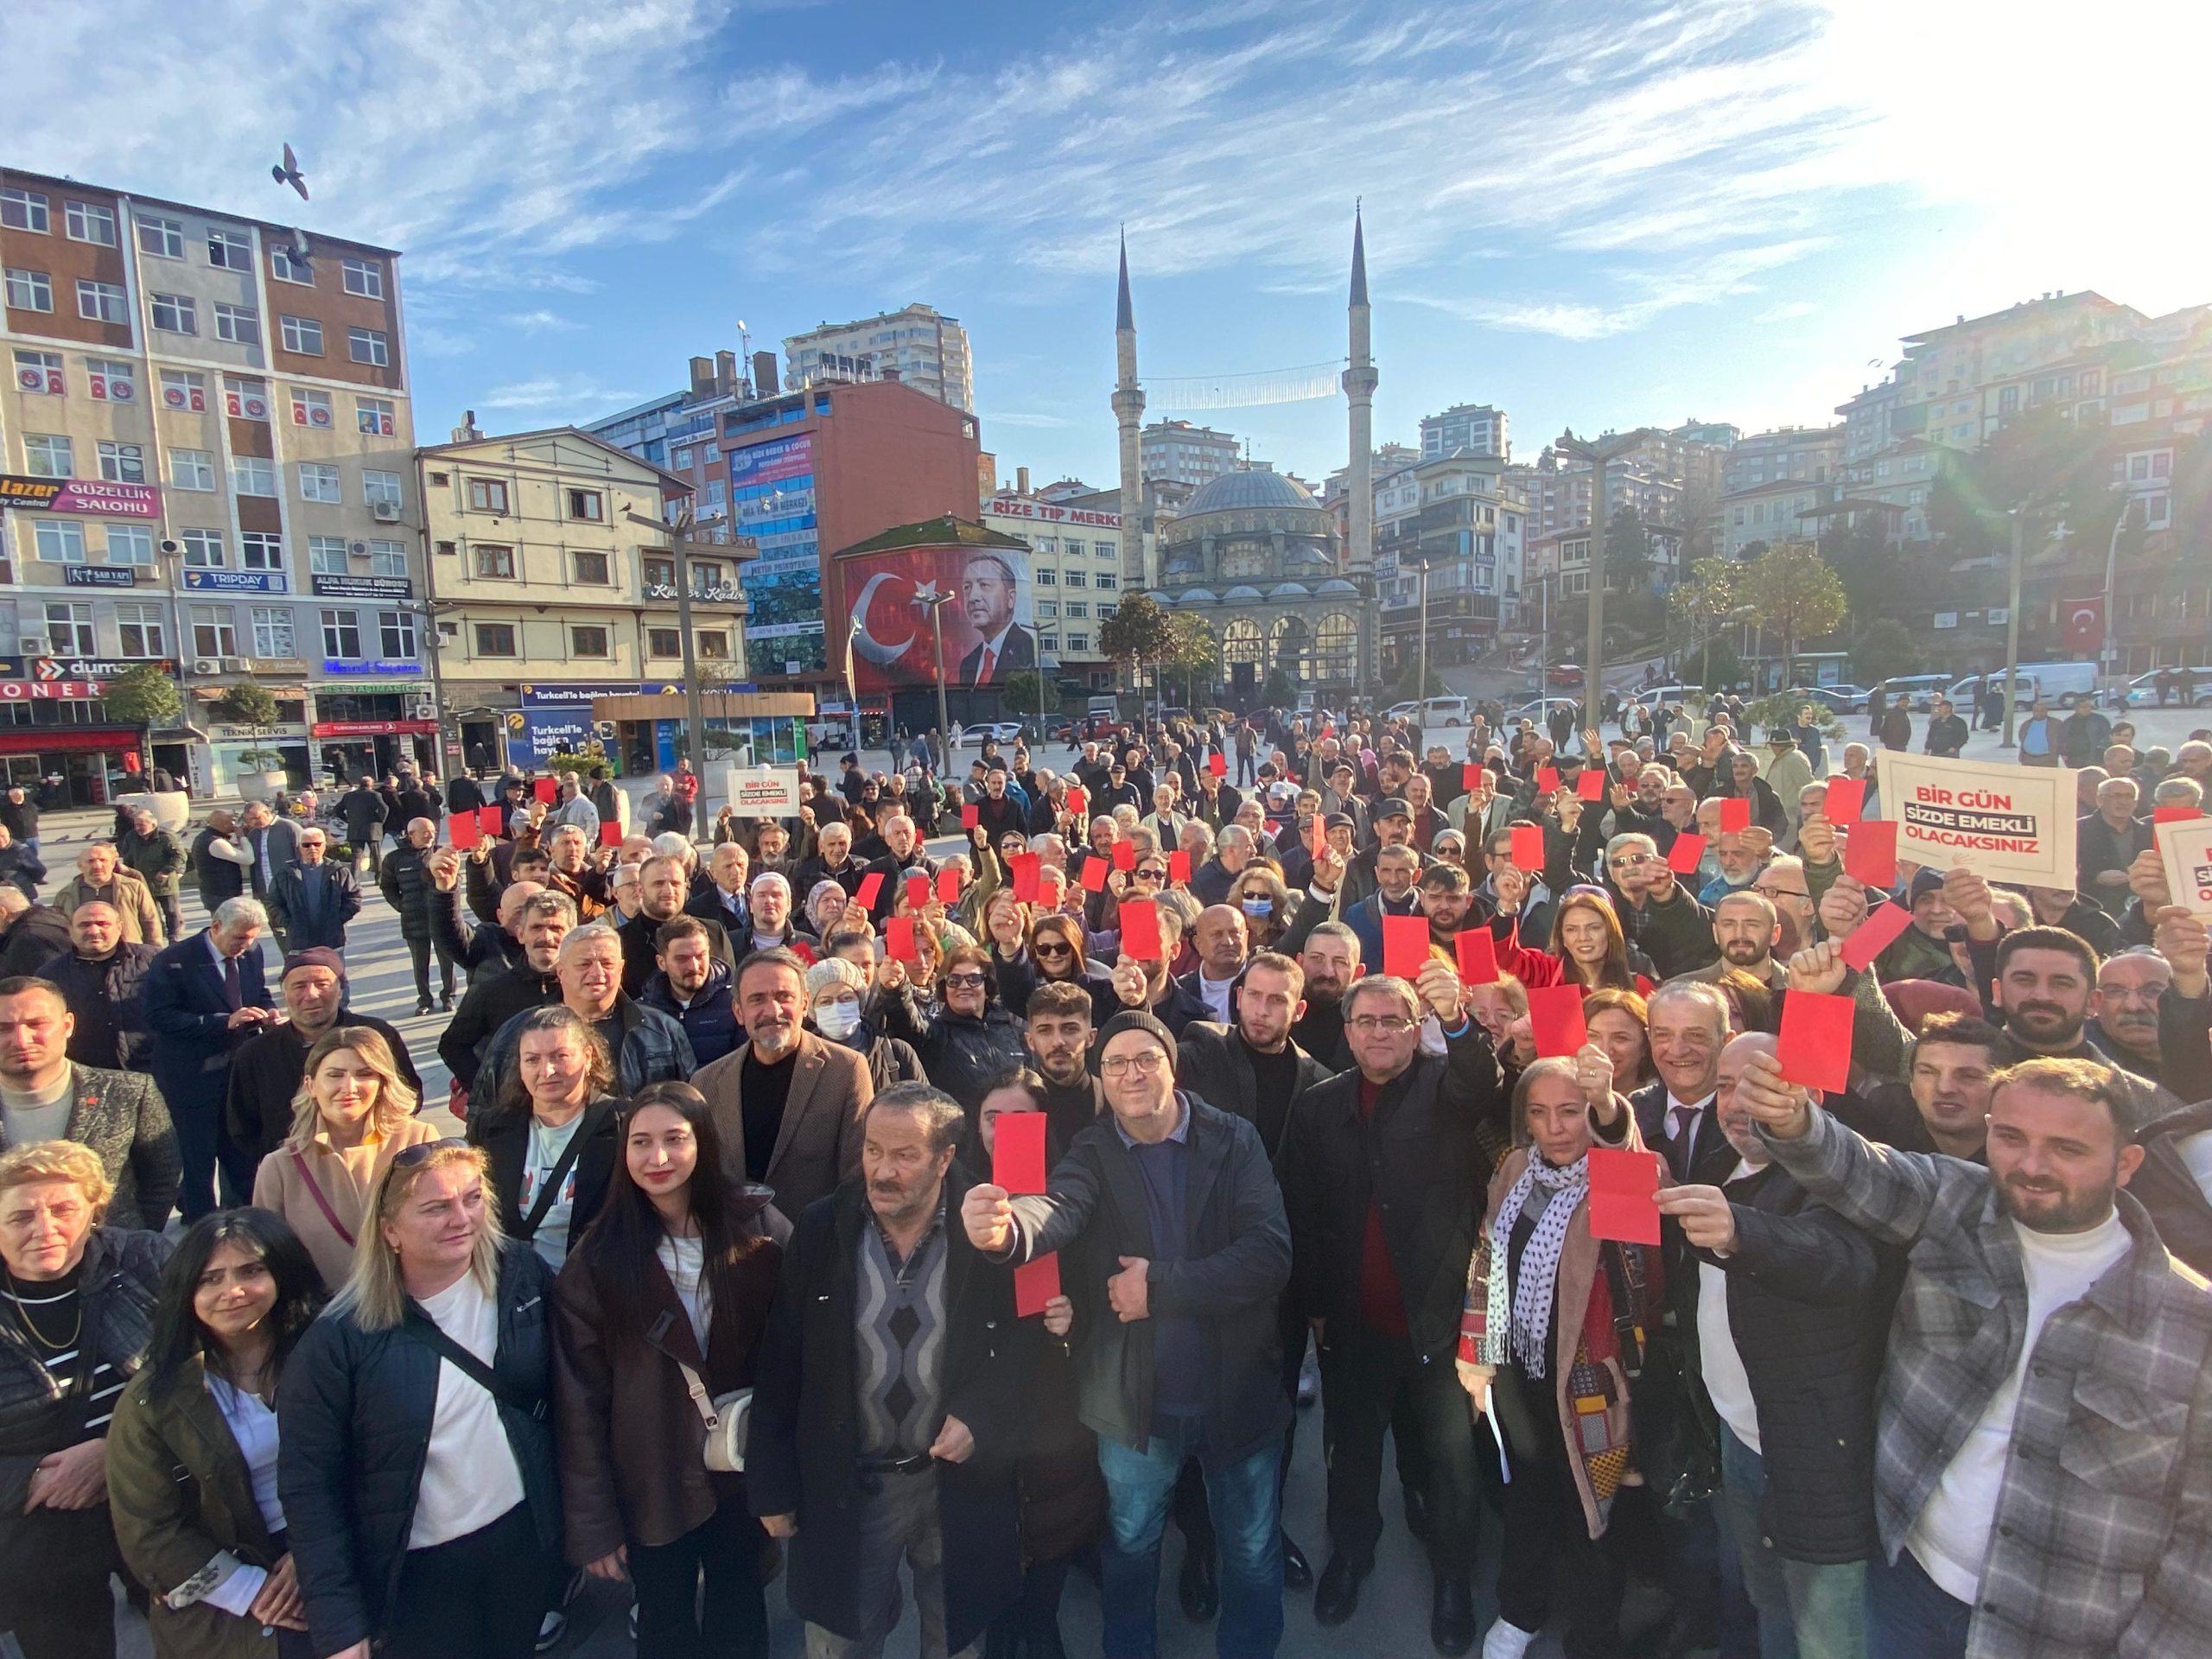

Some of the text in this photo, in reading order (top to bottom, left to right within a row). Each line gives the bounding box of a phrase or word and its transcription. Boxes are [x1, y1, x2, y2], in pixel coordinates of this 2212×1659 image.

[68, 482, 151, 500] GÜZELLİK
[75, 499, 149, 513] SALONU
[994, 500, 1033, 517] RİZE
[1039, 505, 1065, 520] TIP
[209, 573, 262, 585] TRIPDAY
[531, 724, 582, 735] Turkcell'le
[1916, 784, 2012, 810] BİR GÜN
[1906, 804, 2033, 833] SİZDE EMEKLİ
[1905, 825, 2039, 854] OLACAKSINIZ
